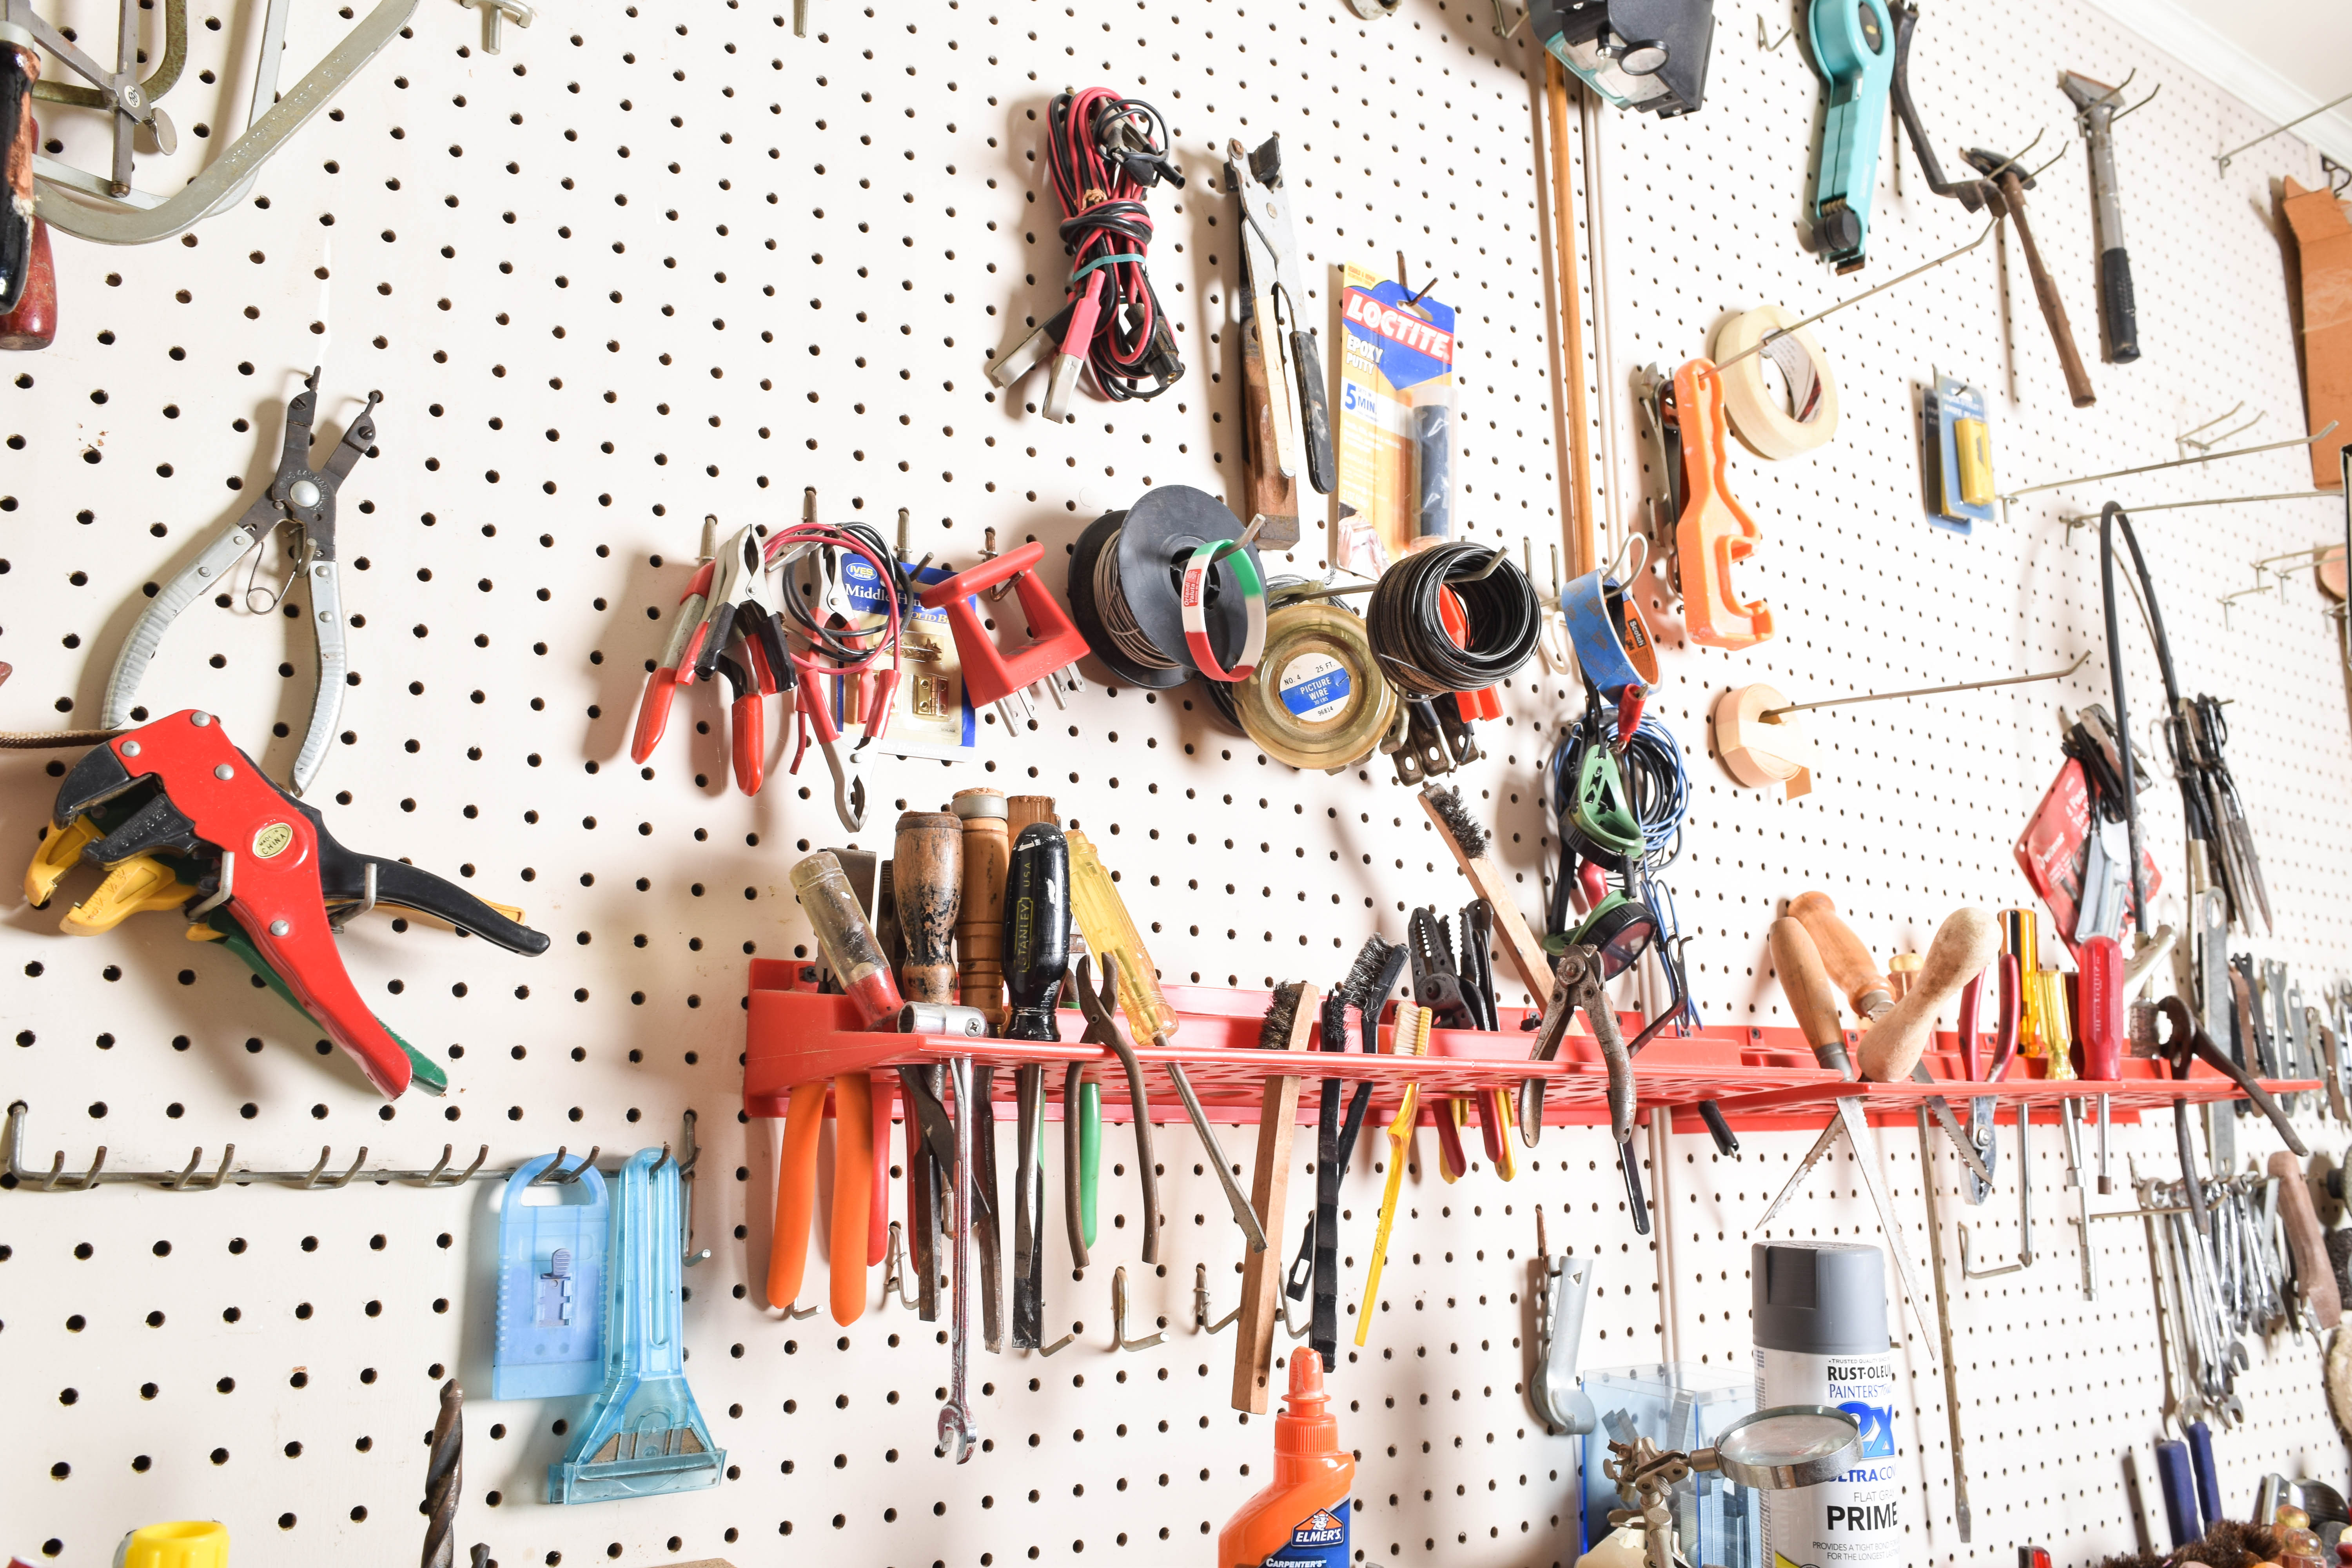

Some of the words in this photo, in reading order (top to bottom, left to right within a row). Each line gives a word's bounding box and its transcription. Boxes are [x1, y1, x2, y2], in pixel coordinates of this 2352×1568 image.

[1346, 294, 1450, 358] LOCTITE
[1346, 332, 1384, 364] EPOXY
[1345, 351, 1375, 375] PUTTY
[1345, 383, 1356, 410] 5
[850, 565, 874, 576] IVES
[845, 583, 890, 602] Middle
[1630, 621, 1644, 646] Scotch
[1626, 639, 1635, 651] 3M
[1284, 677, 1296, 685] NO.
[1300, 677, 1332, 695] PICTURE
[1308, 687, 1329, 701] WIRE
[1318, 706, 1334, 716] 96814
[261, 833, 287, 855] CHINA
[1018, 904, 1030, 965] STANLEY
[1827, 1469, 1878, 1482] LTRA
[1854, 1491, 1877, 1502] FLAT
[1295, 1528, 1341, 1543] ELMER'S
[1812, 1541, 1847, 1552] PROVIDES
[1266, 1558, 1323, 1568] CARPENTER'S
[1827, 1552, 1842, 1560] FOR
[1859, 1551, 1885, 1561] LONGEST
